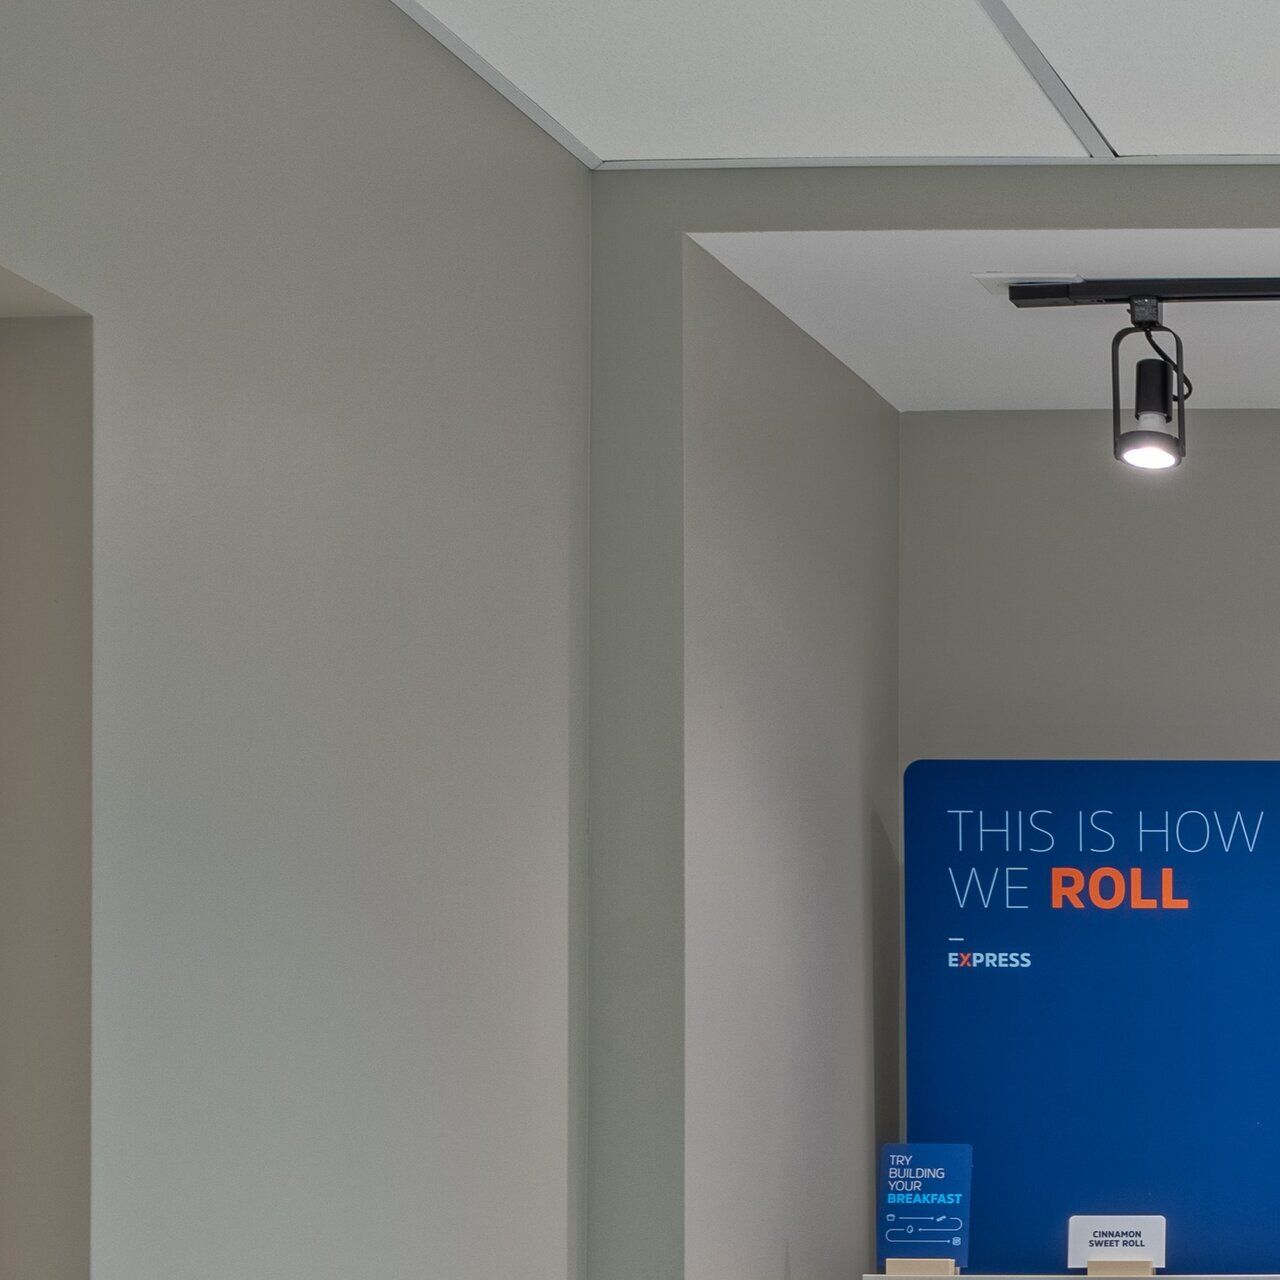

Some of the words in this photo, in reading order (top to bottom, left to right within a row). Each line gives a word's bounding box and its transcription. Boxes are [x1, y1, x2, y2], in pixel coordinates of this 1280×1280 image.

[947, 810, 1055, 852] THIS
[1079, 810, 1115, 852] IS
[1139, 810, 1264, 852] HOW
[948, 867, 1029, 909] WE
[1051, 866, 1189, 910] ROLL
[948, 952, 1032, 968] EXPRESS
[889, 1155, 912, 1166] TRY
[888, 1168, 945, 1179] BUILDING
[888, 1180, 922, 1191] YOUR
[887, 1193, 963, 1204] BREAKFAST
[1092, 1230, 1142, 1239] CINNAMON
[1088, 1239, 1120, 1248] SWEET
[1122, 1239, 1146, 1248] ROLL
